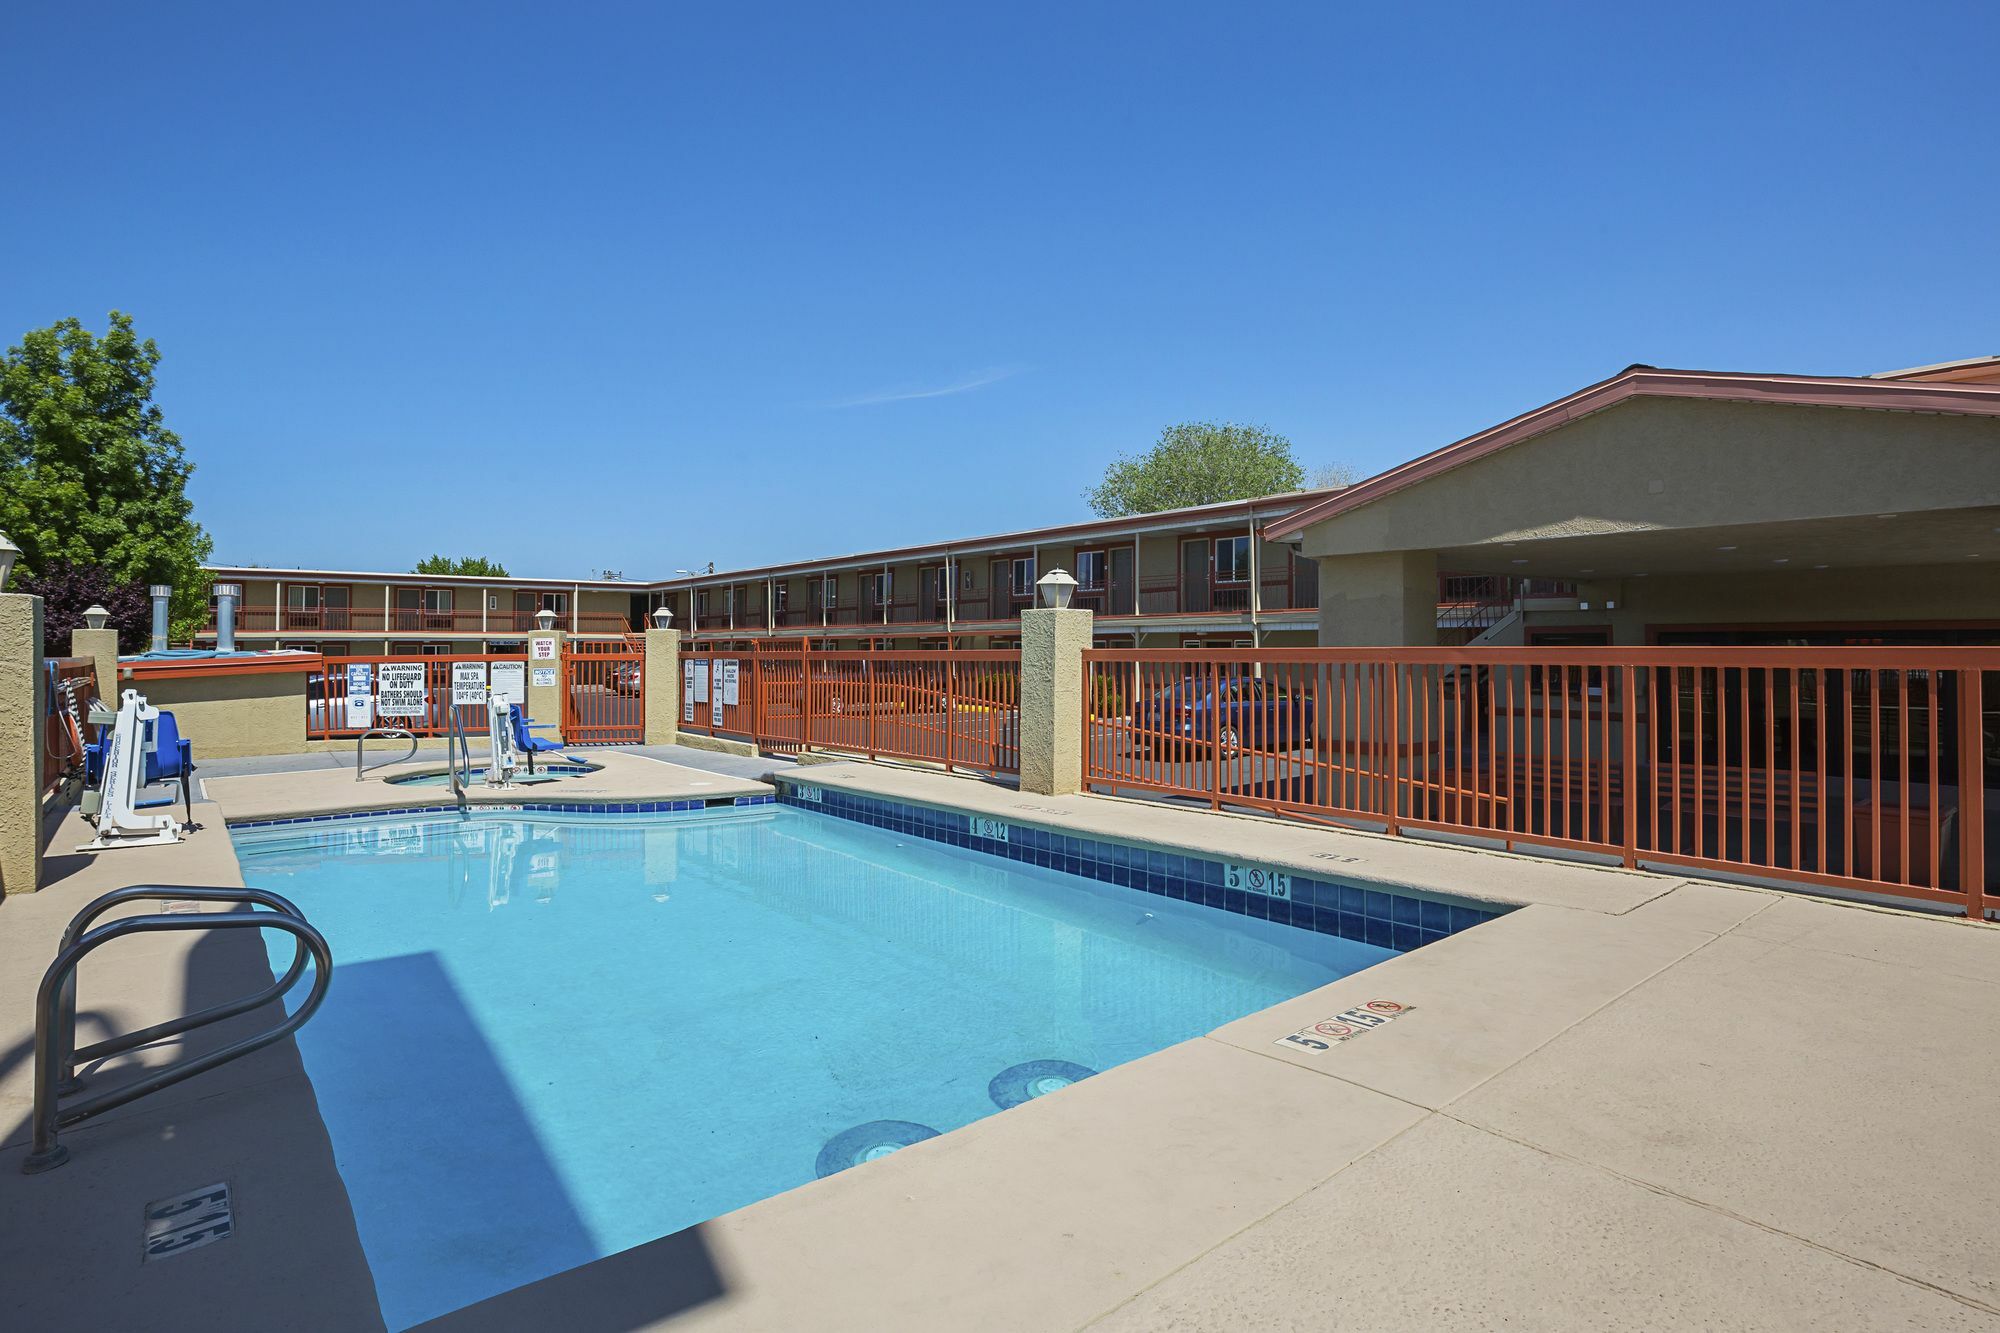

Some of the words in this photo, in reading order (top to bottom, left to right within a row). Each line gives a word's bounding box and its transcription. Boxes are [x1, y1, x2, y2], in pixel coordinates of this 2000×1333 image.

[454, 681, 485, 690] TEMPERATURE
[460, 672, 470, 680] MAX
[471, 672, 479, 680] SPA
[381, 698, 391, 706] NOT
[392, 698, 406, 706] SWIM
[407, 698, 422, 706] ALONE
[971, 817, 978, 834] 4
[996, 822, 1005, 840] 1.2
[1229, 865, 1240, 887] 5
[1269, 872, 1286, 896] 1.5
[1286, 1035, 1329, 1050] 5
[1335, 1010, 1385, 1028] 1.5
[150, 1189, 226, 1219] 5
[149, 1212, 230, 1254] 1.5
